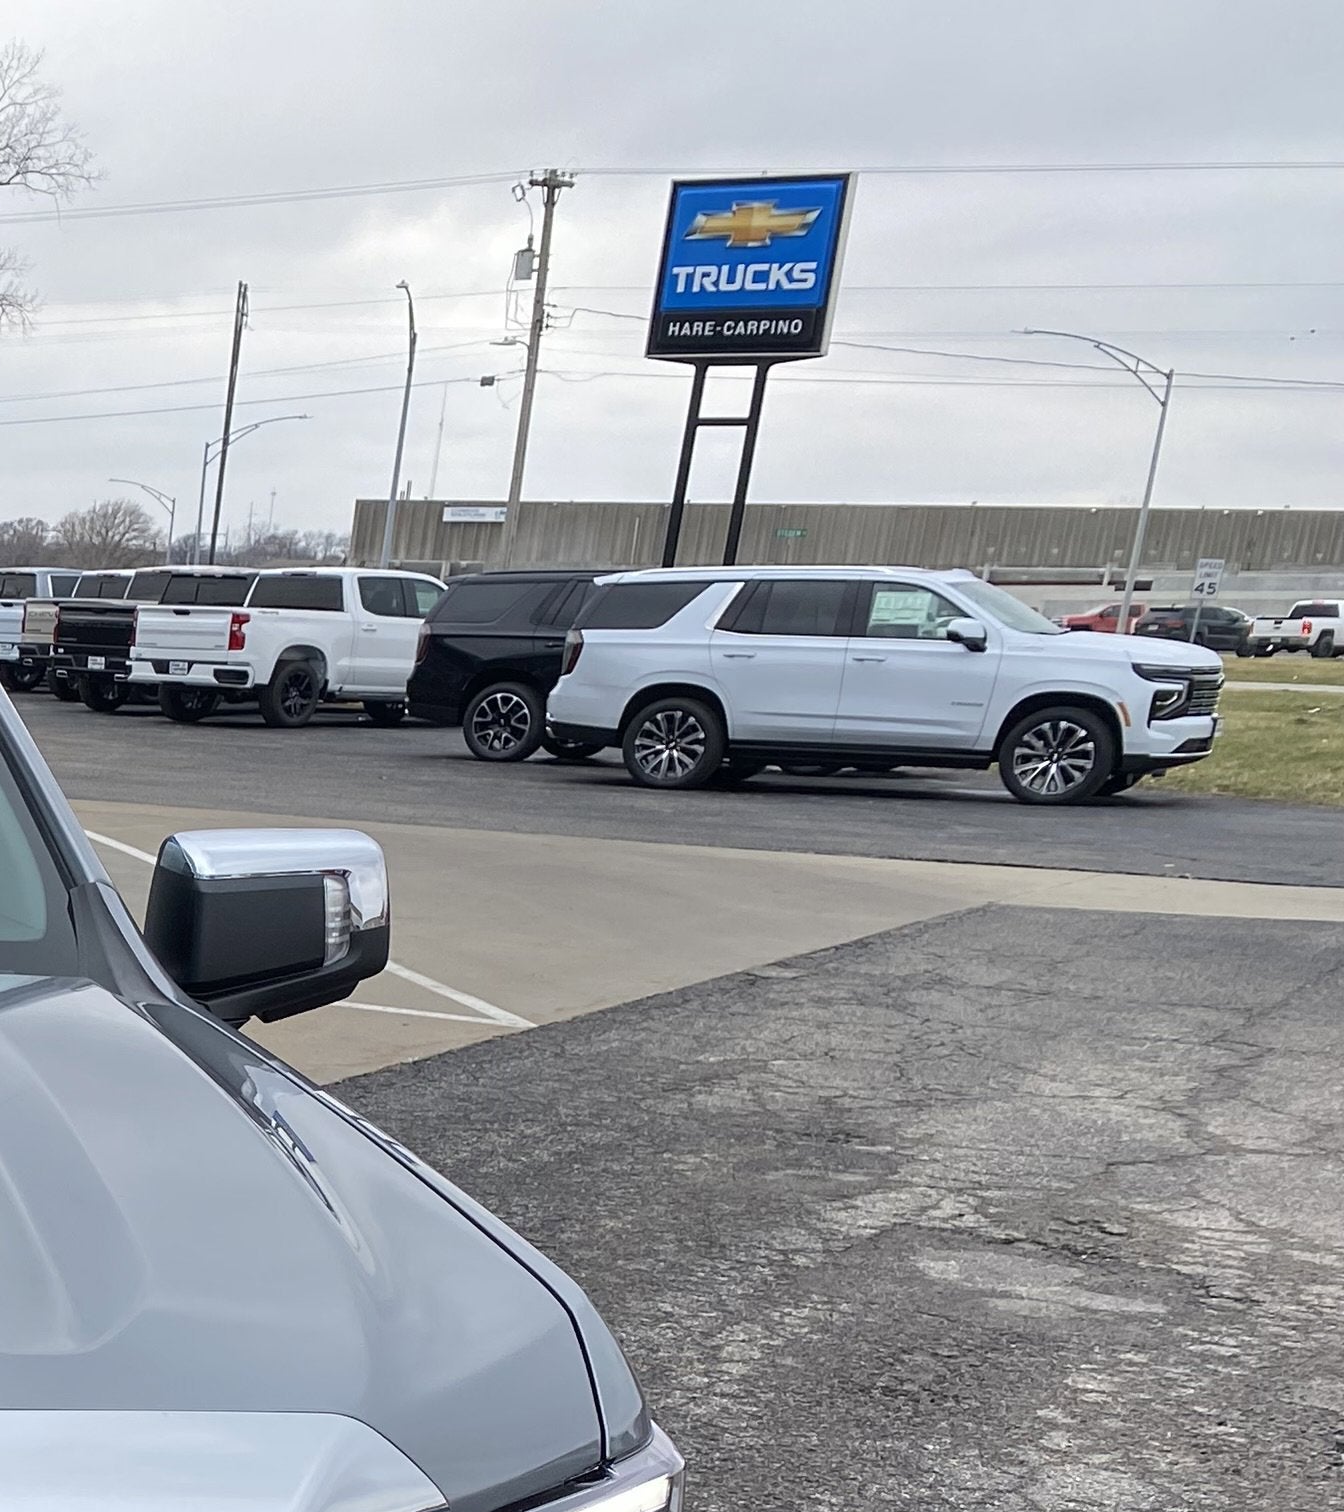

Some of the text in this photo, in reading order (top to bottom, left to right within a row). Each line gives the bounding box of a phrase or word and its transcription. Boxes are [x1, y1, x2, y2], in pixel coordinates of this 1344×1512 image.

[672, 261, 818, 293] TRUCKS
[668, 318, 803, 337] HARE-CARPINO
[1194, 582, 1217, 595] 45
